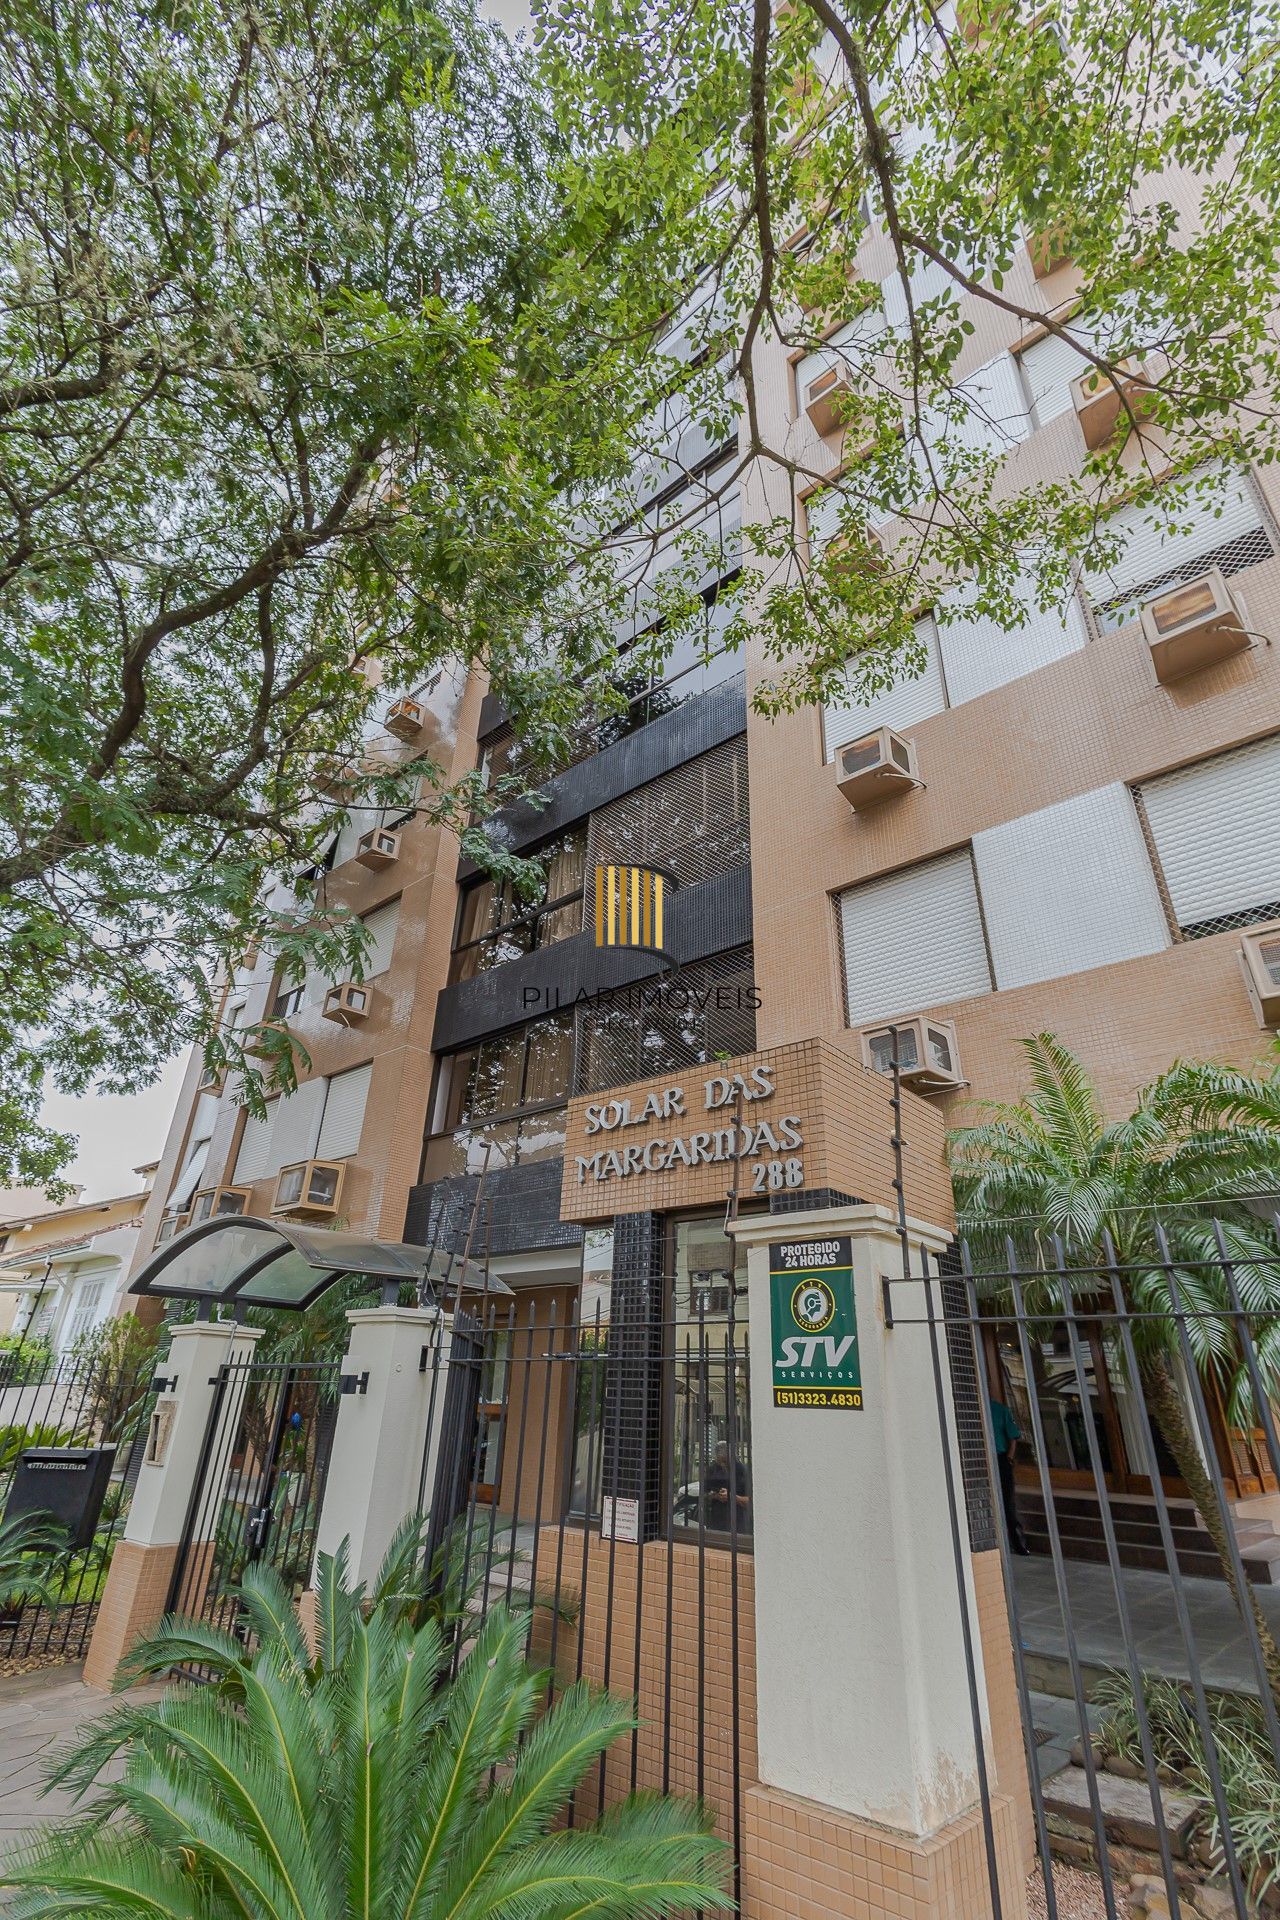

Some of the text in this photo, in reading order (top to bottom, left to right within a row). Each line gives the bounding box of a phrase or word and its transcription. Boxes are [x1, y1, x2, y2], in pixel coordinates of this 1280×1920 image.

[584, 1066, 776, 1135] SOLAR DAS
[574, 1116, 804, 1185] MARGARIDAS
[751, 1158, 804, 1193] 288
[780, 1241, 841, 1258] PROTEGIDO
[785, 1253, 837, 1268] 24 HORAS
[775, 1335, 856, 1368] STV
[781, 1371, 854, 1380] SERVIÇOS
[777, 1391, 861, 1407] (51)3323.4830
